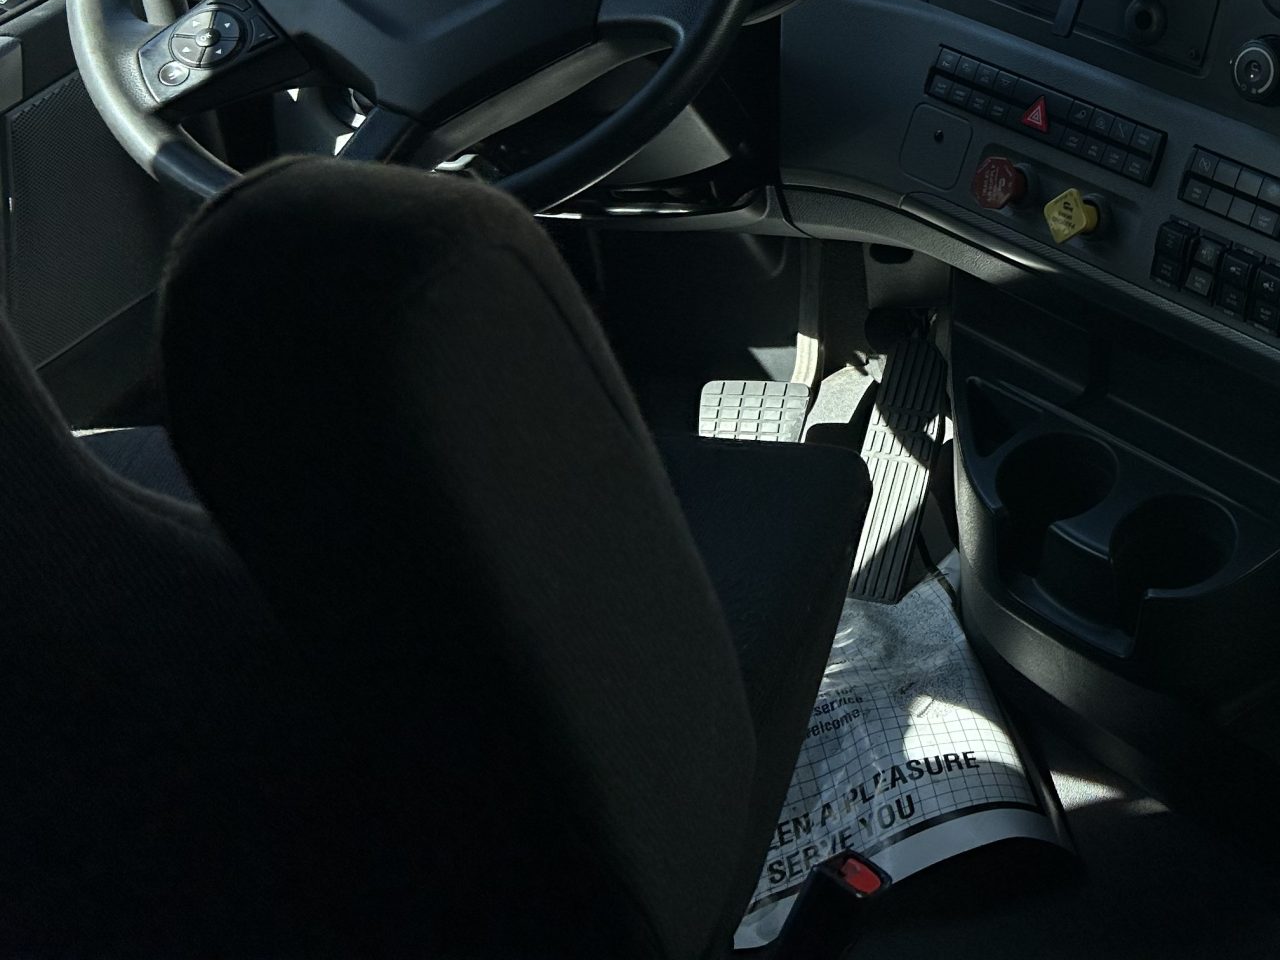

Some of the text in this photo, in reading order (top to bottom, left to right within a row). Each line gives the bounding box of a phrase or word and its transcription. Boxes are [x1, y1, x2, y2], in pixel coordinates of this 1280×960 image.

[200, 32, 212, 42] OK
[814, 695, 863, 717] service
[820, 802, 834, 827] A
[844, 751, 981, 813] PLEASURE
[767, 794, 916, 885] SERVE YOU
